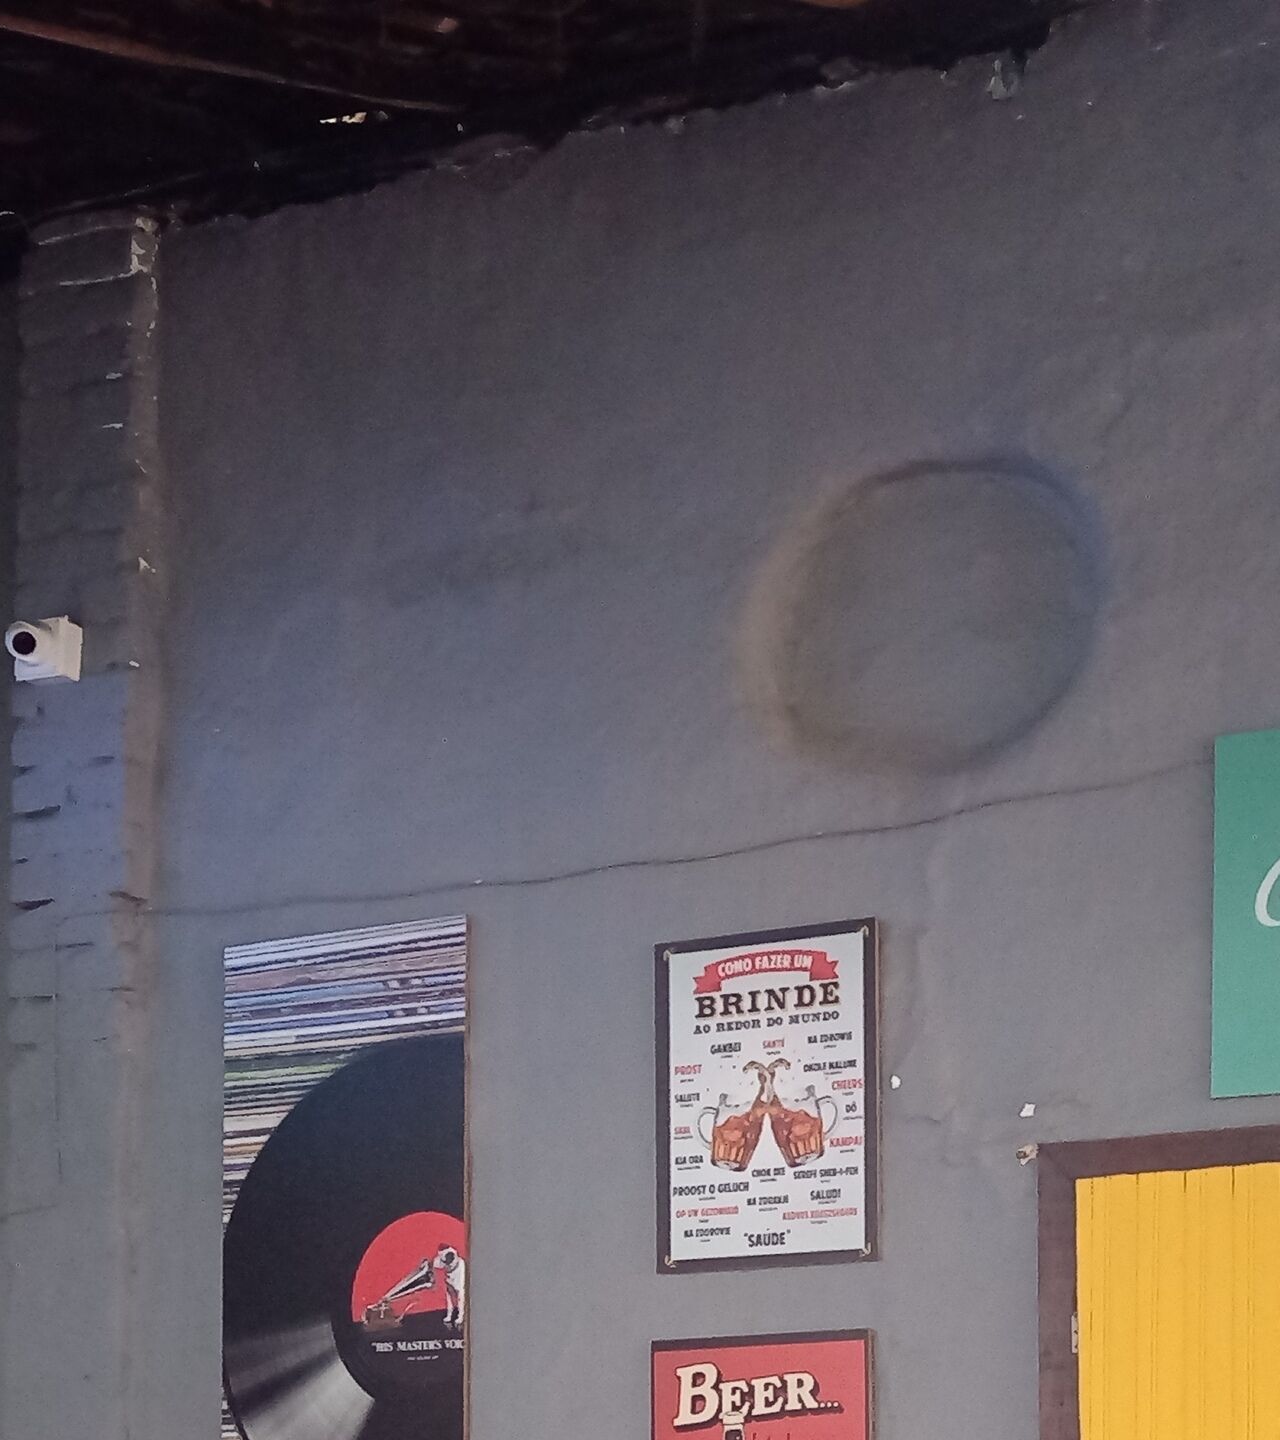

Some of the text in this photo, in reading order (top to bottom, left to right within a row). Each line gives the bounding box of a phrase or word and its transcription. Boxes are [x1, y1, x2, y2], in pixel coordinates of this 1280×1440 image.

[718, 956, 752, 976] COMO
[755, 953, 789, 970] FAZER
[694, 982, 840, 1018] BRINDE
[693, 1010, 840, 1035] AO REDOR DO MUNDO
[674, 1064, 702, 1075] PROST
[831, 1079, 862, 1090] CHEERS
[673, 1184, 707, 1197] PROOST
[444, 1338, 465, 1350] VOIC
